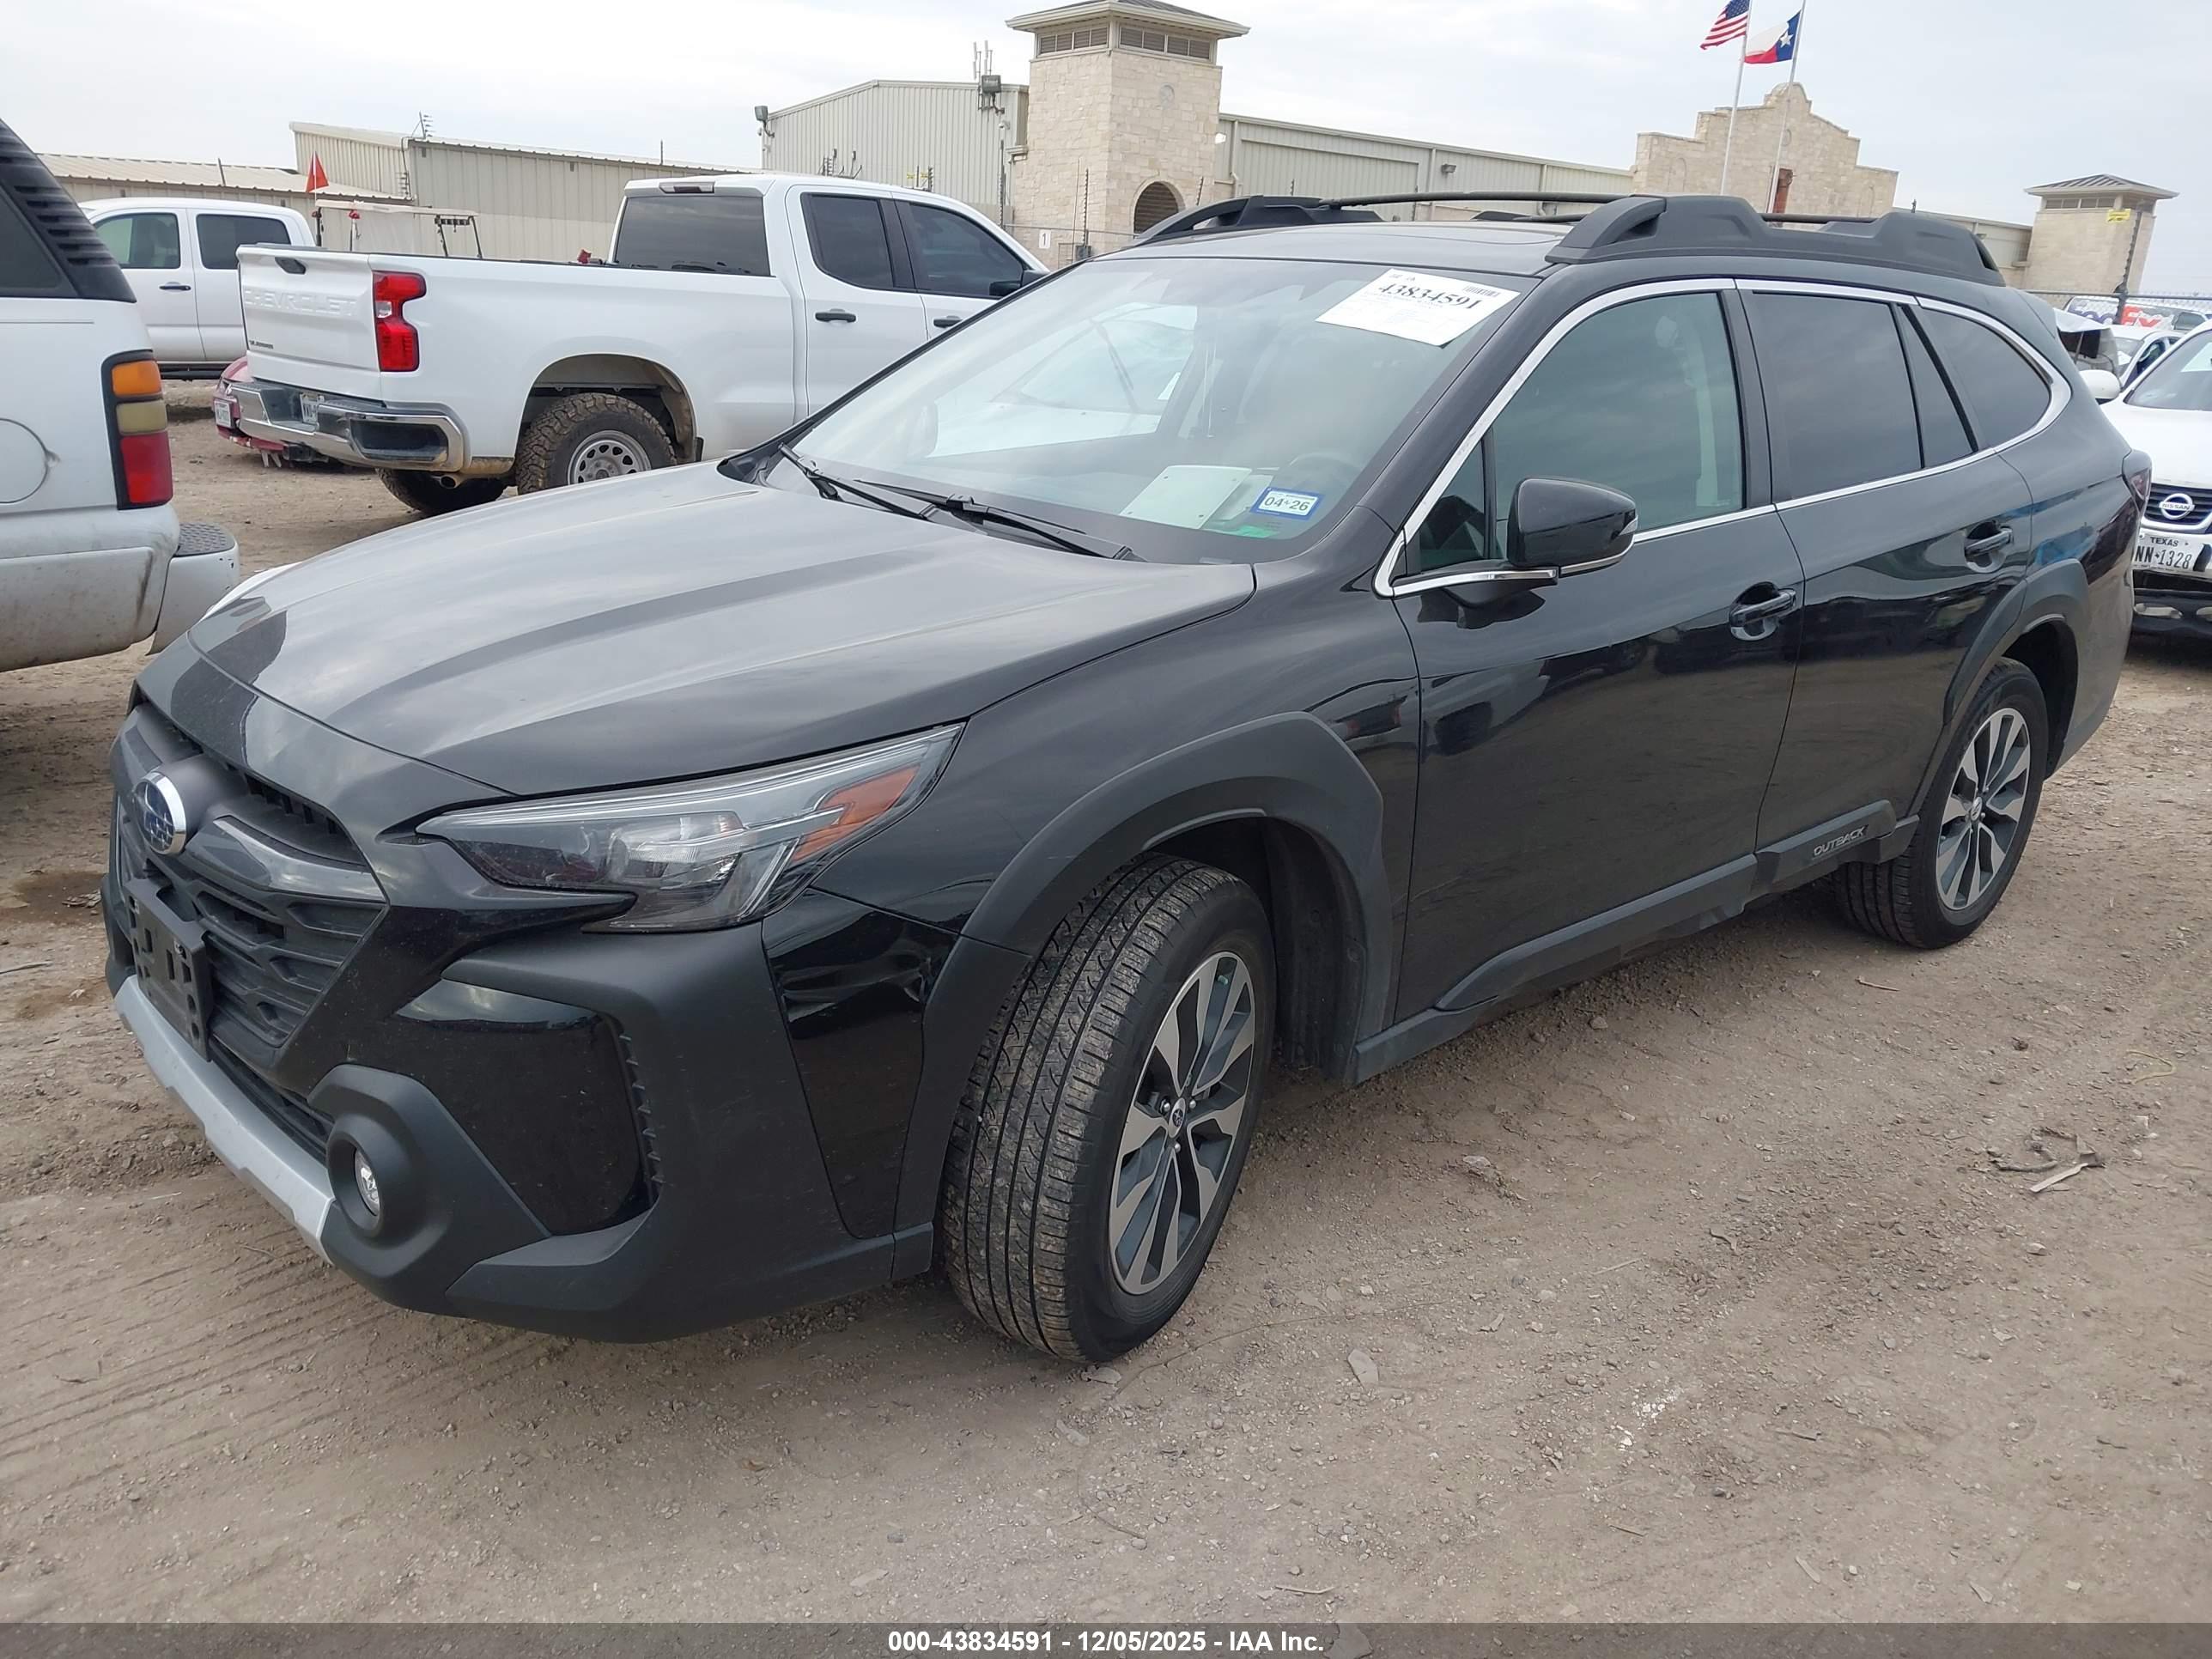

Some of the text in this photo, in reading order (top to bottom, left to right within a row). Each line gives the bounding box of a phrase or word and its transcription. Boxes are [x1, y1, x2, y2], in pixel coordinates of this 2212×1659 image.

[1378, 283, 1483, 309] 43834591
[2149, 536, 2179, 548] TEXAS
[1814, 825, 1866, 856] OUTBACK
